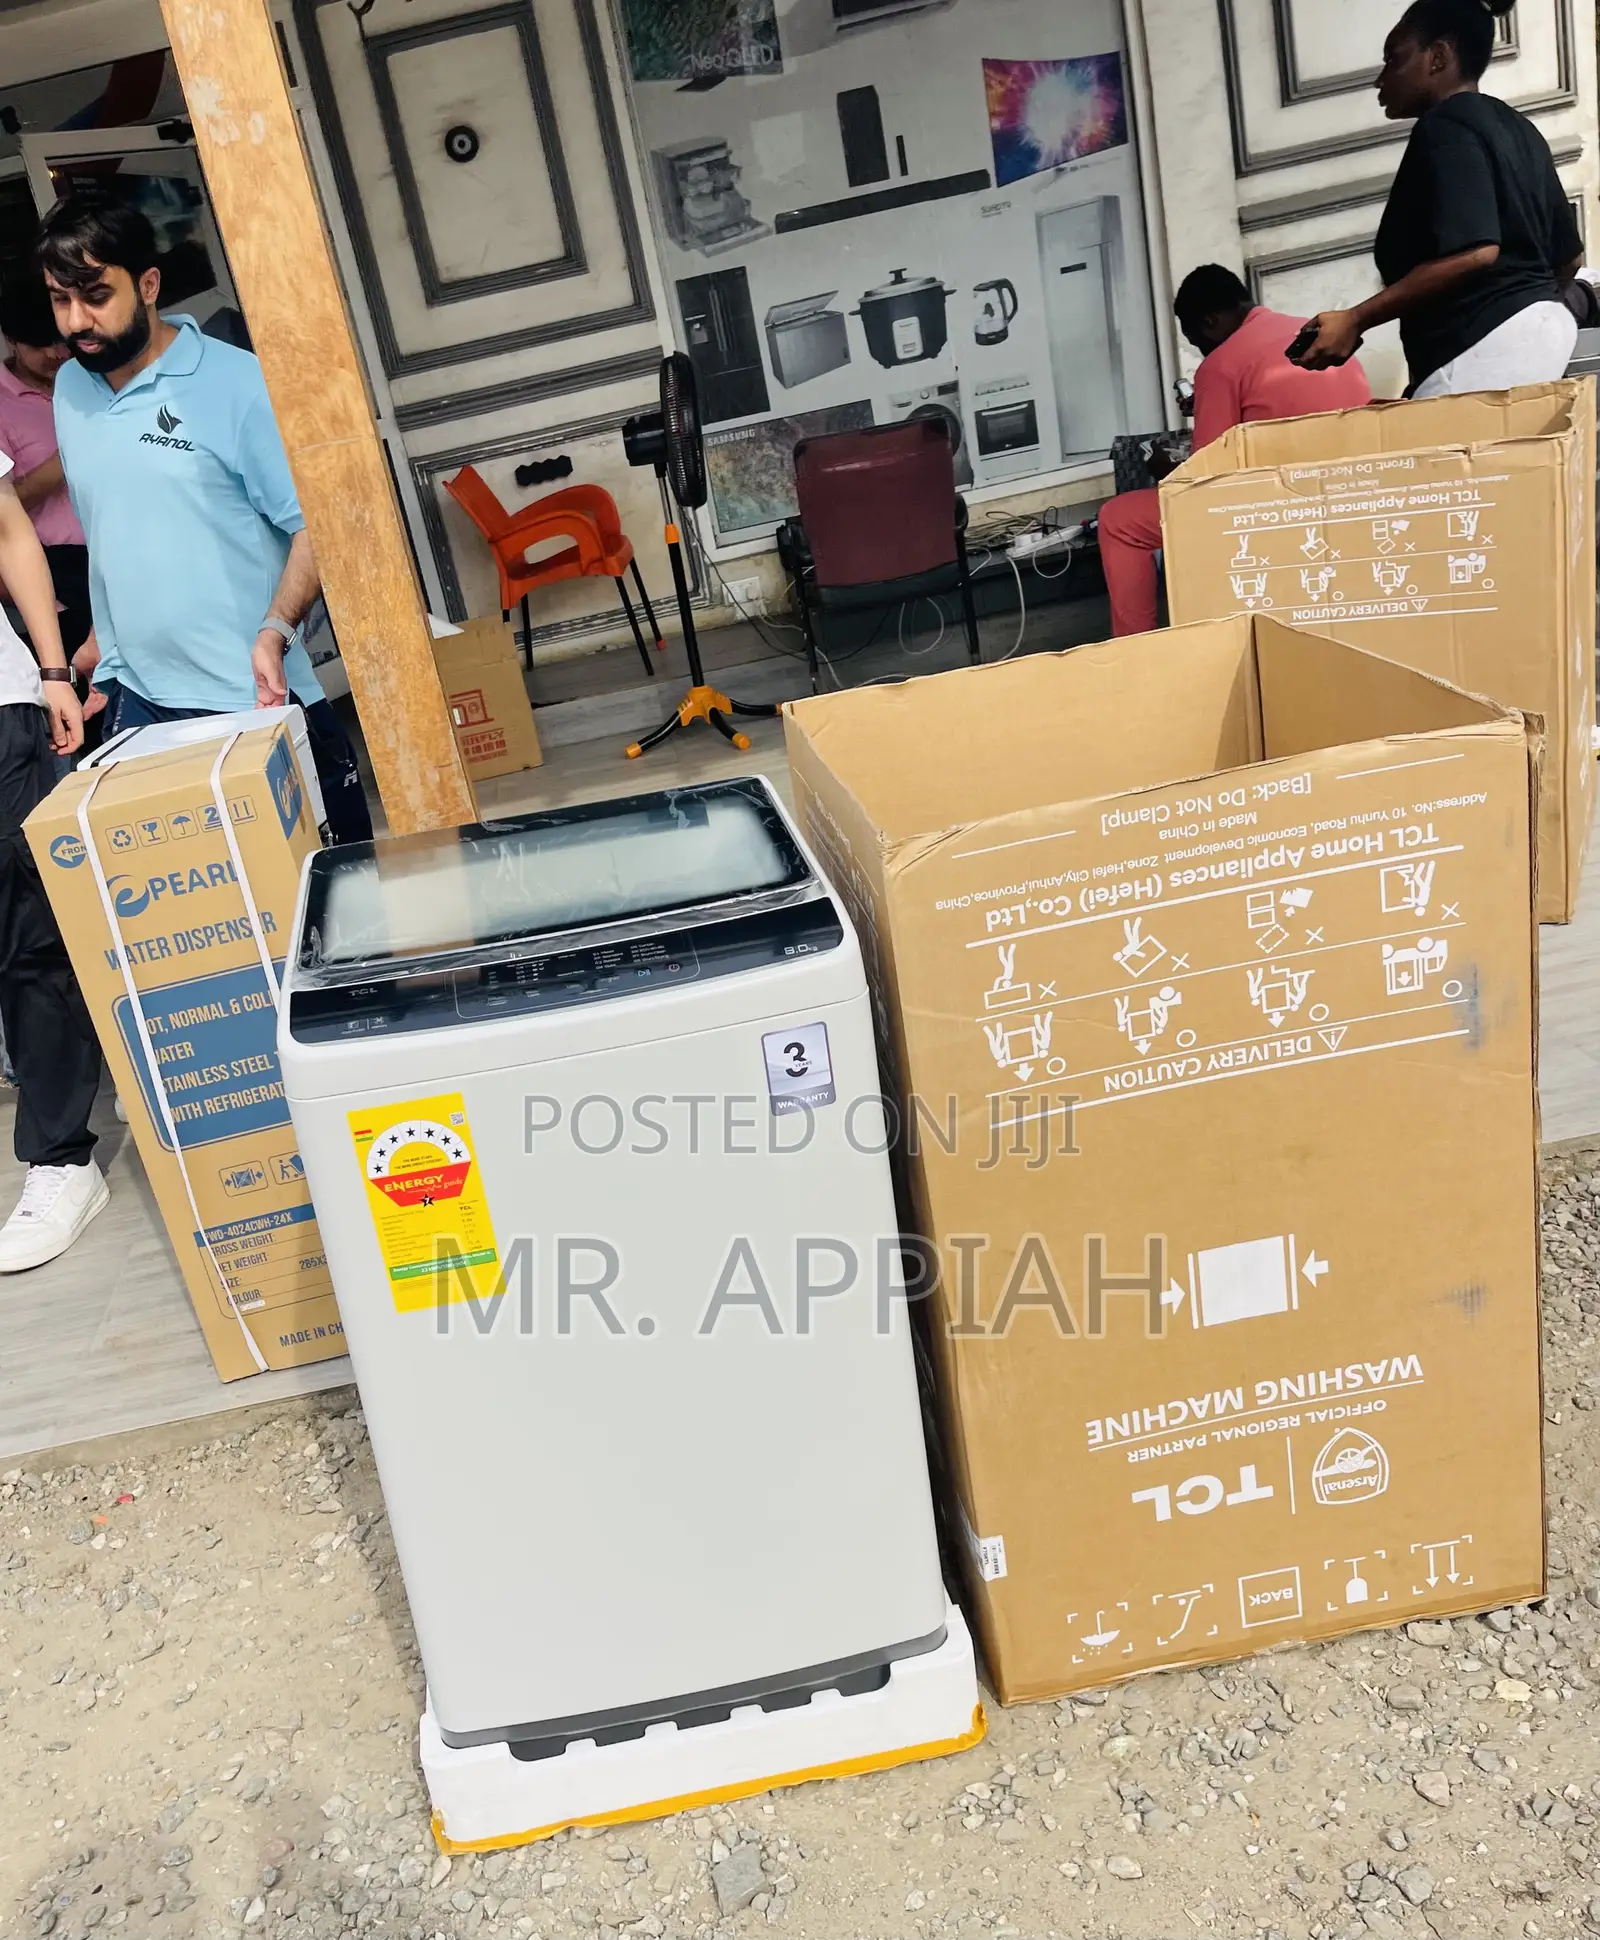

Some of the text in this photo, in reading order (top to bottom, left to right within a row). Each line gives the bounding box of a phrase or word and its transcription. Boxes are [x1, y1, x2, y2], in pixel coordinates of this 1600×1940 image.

[726, 44, 775, 68] QLED
[139, 433, 196, 452] AYANOL
[707, 429, 756, 447] SAMSUNG
[1331, 465, 1353, 477] Not
[1356, 462, 1372, 473] Do
[1331, 496, 1405, 513] Appliances
[1409, 492, 1450, 505] Home
[1453, 489, 1482, 502] TCL
[1283, 504, 1327, 522] (Hefei)
[1292, 601, 1408, 620] DELIVERY CAUTION
[1101, 772, 1312, 836] [Back: Do Not Clamp]
[1392, 807, 1407, 819] 10
[1158, 811, 1257, 841] Made in China
[1350, 811, 1389, 825] Yunhu
[1247, 826, 1308, 846] Economic
[1389, 822, 1440, 847] TCL
[61, 844, 88, 856] FRON
[1164, 836, 1245, 863] Development
[1310, 834, 1384, 860] Home
[1169, 845, 1305, 889] Appliances
[148, 860, 239, 901] PEARL
[1079, 872, 1163, 913] (Hefei)
[104, 911, 278, 971] WATER DISPENSR
[348, 987, 378, 996] TCL
[145, 1016, 169, 1035] OT,
[168, 1002, 229, 1030] NORMAL
[229, 998, 241, 1015] &
[230, 1054, 275, 1078] STEEL
[783, 1041, 809, 1078] 3
[1103, 1035, 1313, 1093] DELIVERY CAUTION
[170, 1081, 286, 1124] WITH REFRIGERAT
[777, 1092, 829, 1109] WARRANTY
[384, 1173, 465, 1193] ENERGY guide
[298, 1255, 328, 1270] 285X3
[279, 1322, 345, 1347] MADE IN CH
[1085, 1354, 1424, 1446] WASHING MACHINE
[1127, 1400, 1388, 1463] OFFICIAL REGIONAL PARTNER
[1131, 1464, 1274, 1522] TCL
[1323, 1474, 1380, 1496] Arsenal
[1248, 1587, 1295, 1608] BACK
